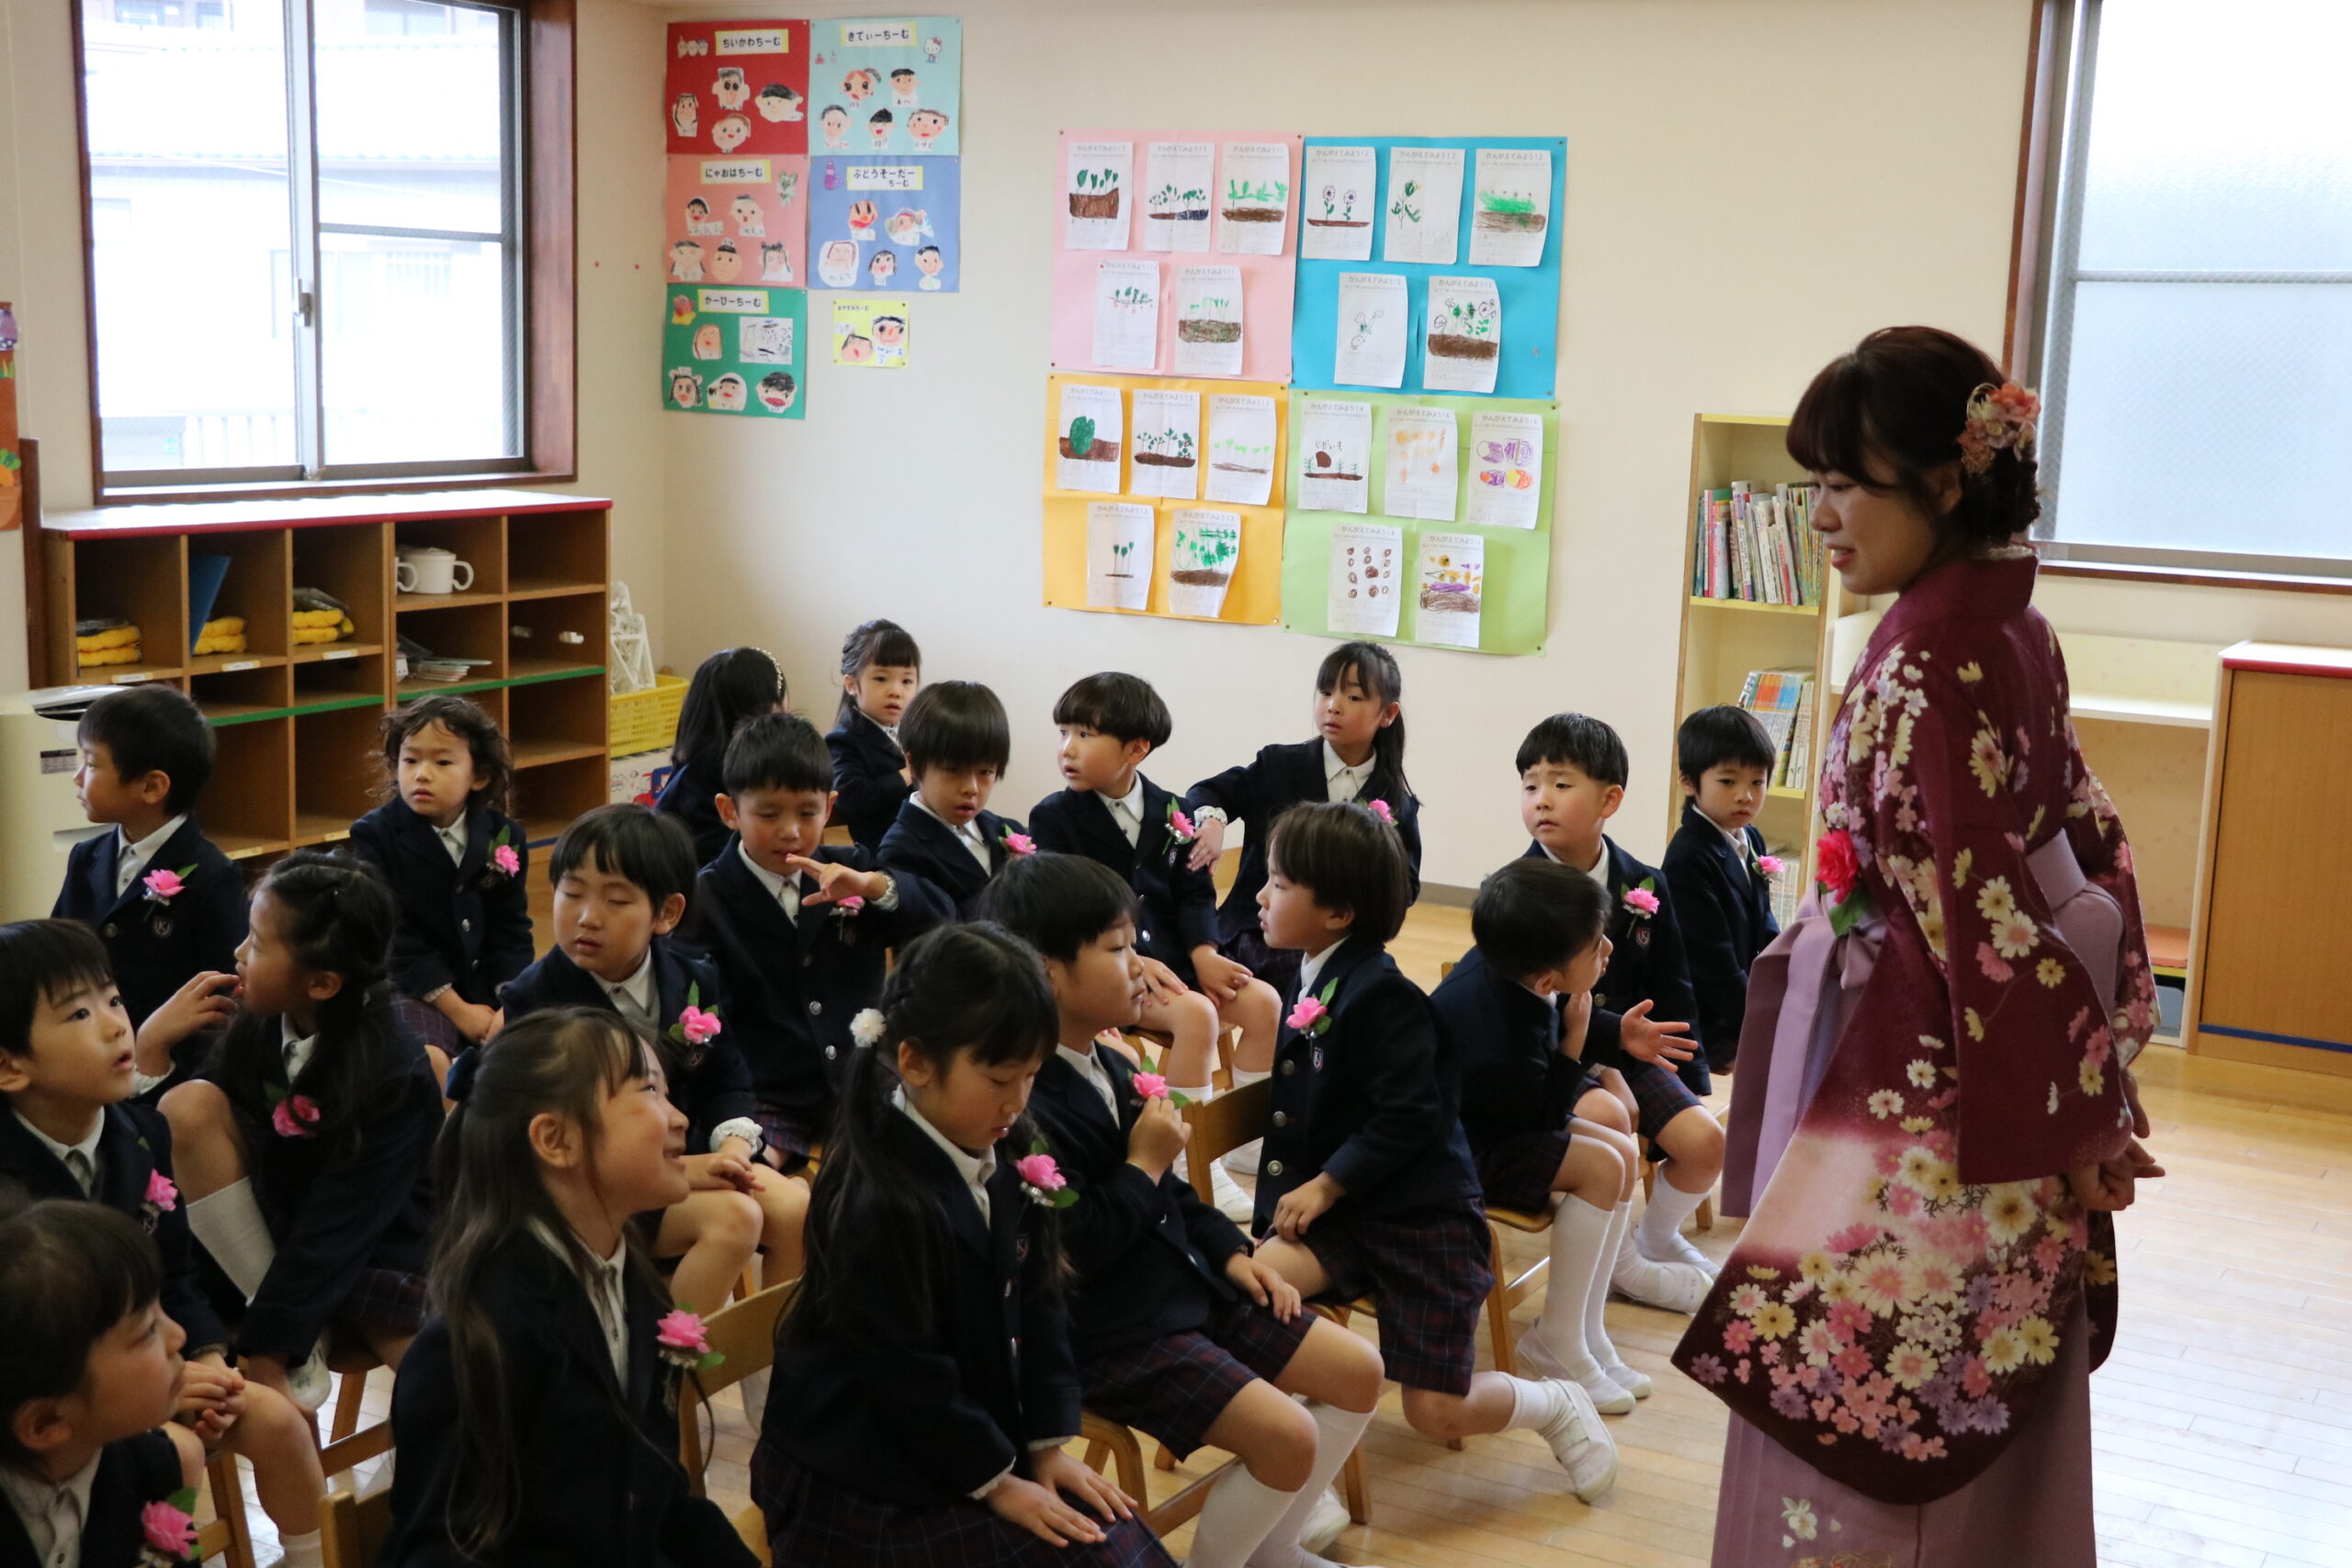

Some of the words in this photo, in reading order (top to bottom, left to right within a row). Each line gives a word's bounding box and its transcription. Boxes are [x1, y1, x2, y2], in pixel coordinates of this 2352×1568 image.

[848, 28, 909, 41] きてぃーちーむ
[722, 36, 780, 49] ちいかわちーむ
[706, 168, 763, 178] にゃおはちーむ
[854, 169, 915, 179] ぶどうそーだー
[888, 180, 909, 188] ちーむ
